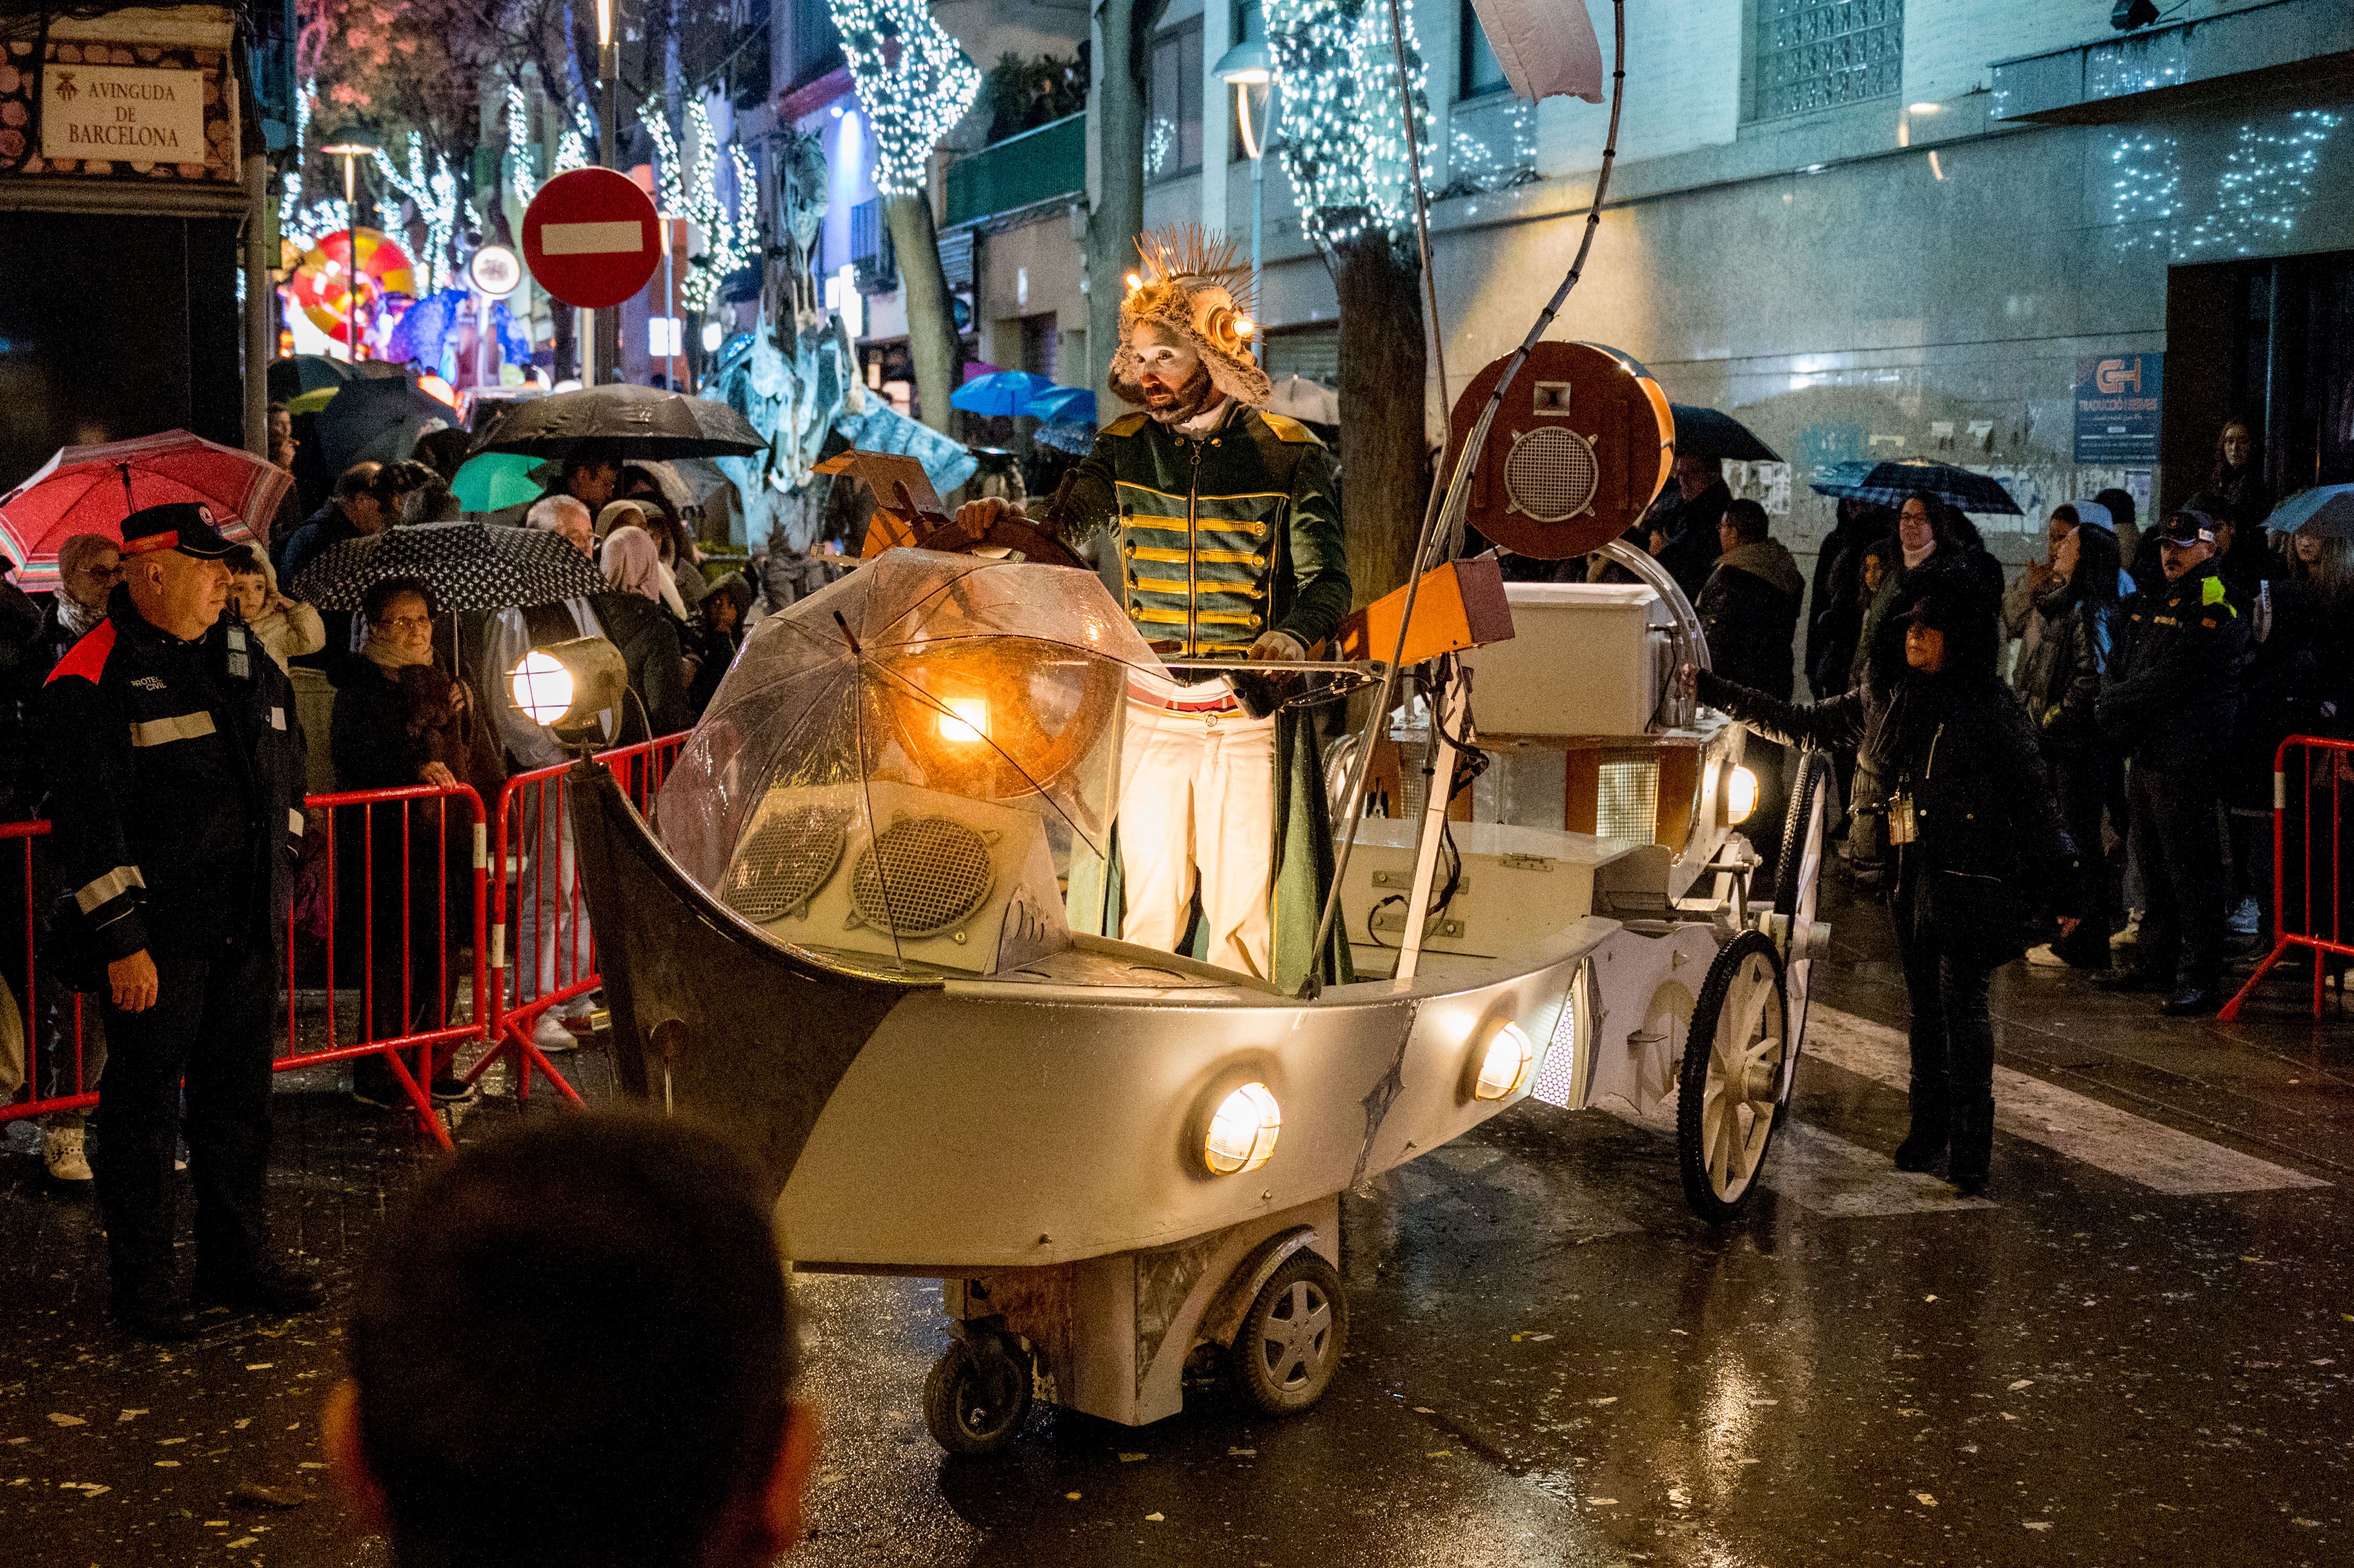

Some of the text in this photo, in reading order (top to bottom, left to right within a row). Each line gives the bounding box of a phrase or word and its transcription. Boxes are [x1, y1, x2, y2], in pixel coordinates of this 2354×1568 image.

[90, 83, 175, 101] AVINGUDA
[115, 106, 137, 123] DE
[69, 124, 179, 148] BARCELONA
[146, 681, 166, 690] CIVIL
